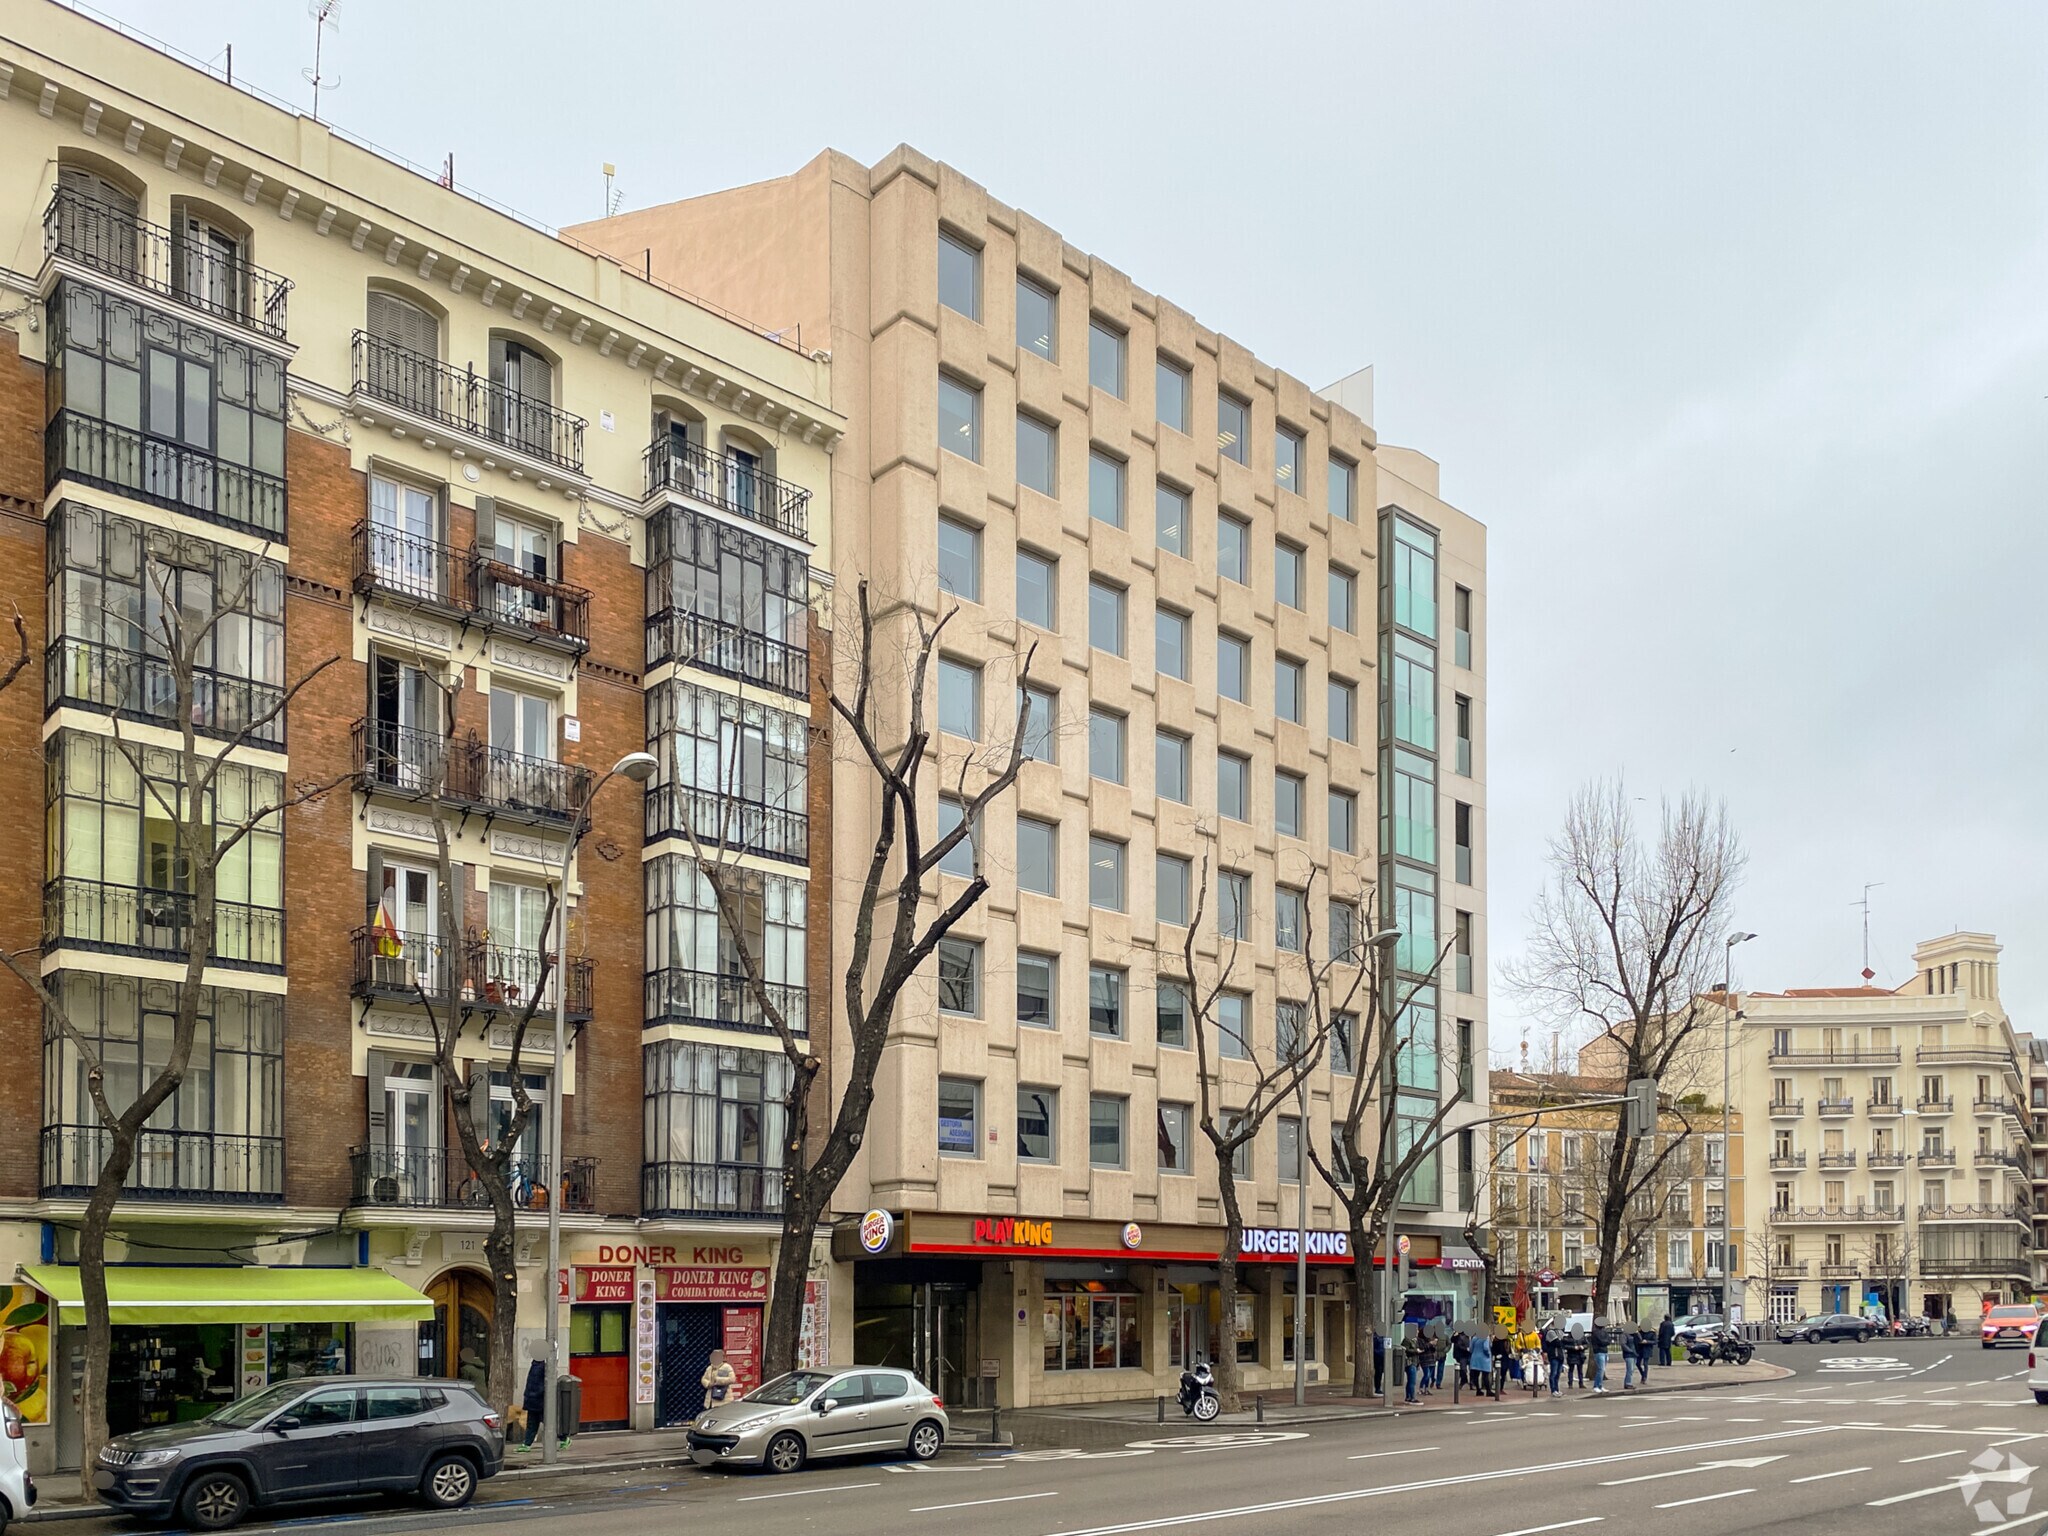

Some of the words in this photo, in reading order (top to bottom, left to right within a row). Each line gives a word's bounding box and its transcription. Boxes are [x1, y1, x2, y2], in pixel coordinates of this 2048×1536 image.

[863, 1216, 884, 1231] BURGER
[864, 1224, 885, 1243] KING
[460, 1240, 475, 1250] 121
[1241, 1229, 1300, 1253] URGER
[1305, 1231, 1347, 1255] KING
[599, 1245, 677, 1264] DONER
[693, 1247, 743, 1264] KING
[1452, 1259, 1485, 1268] DENTIX
[591, 1270, 631, 1283] DONER
[672, 1270, 715, 1285] DONER
[718, 1271, 749, 1285] KING
[595, 1285, 626, 1298] KING
[671, 1287, 706, 1298] COMIDA
[707, 1287, 736, 1298] TORCA
